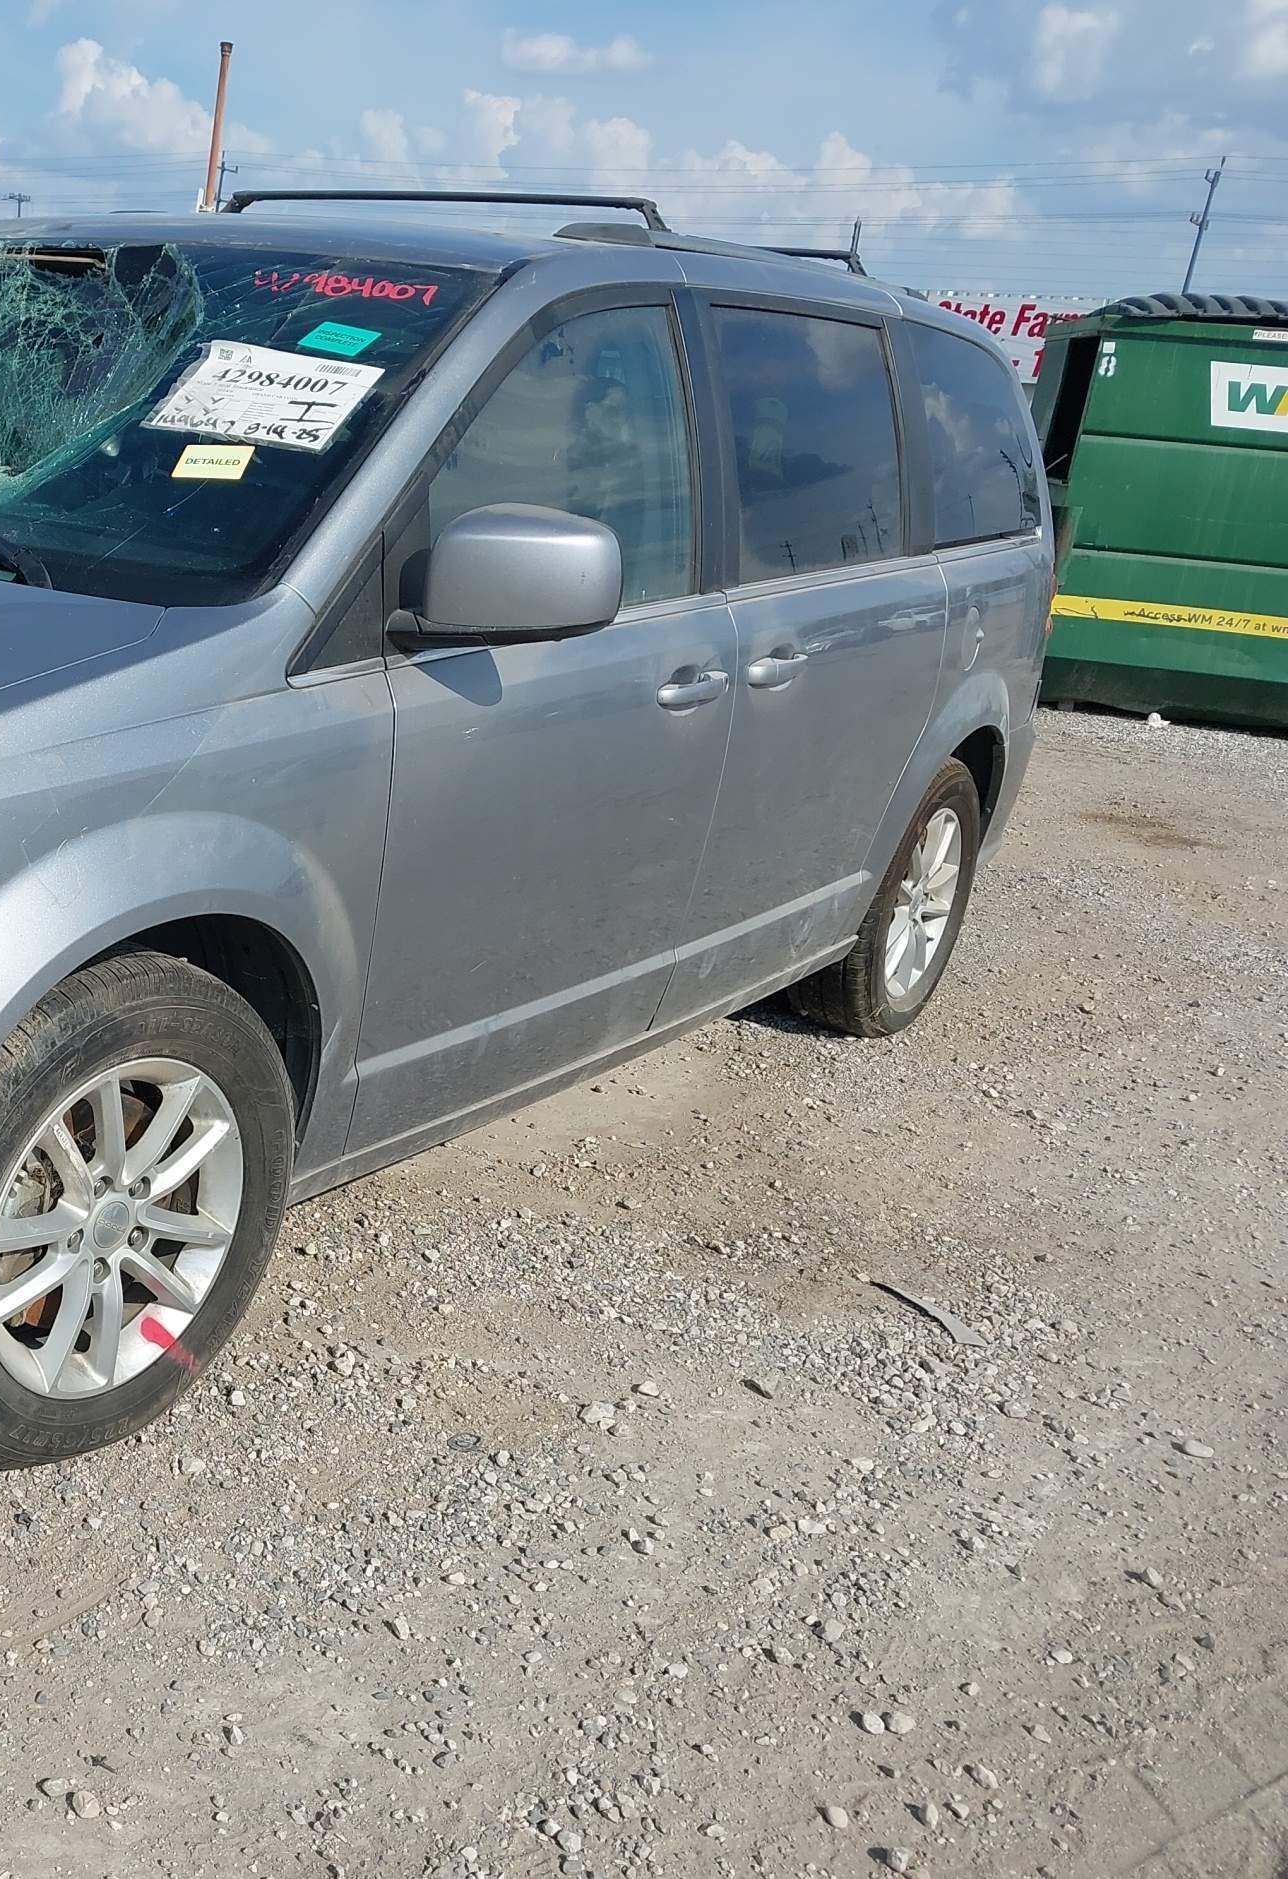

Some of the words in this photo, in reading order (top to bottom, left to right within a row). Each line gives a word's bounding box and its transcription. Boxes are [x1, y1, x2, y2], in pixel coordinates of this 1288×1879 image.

[212, 367, 348, 395] 42984007
[184, 458, 241, 466] DETAILED
[1136, 608, 1183, 622] Access
[1187, 612, 1214, 625] WM
[1216, 616, 1251, 629] 24/7
[1254, 622, 1266, 632] at
